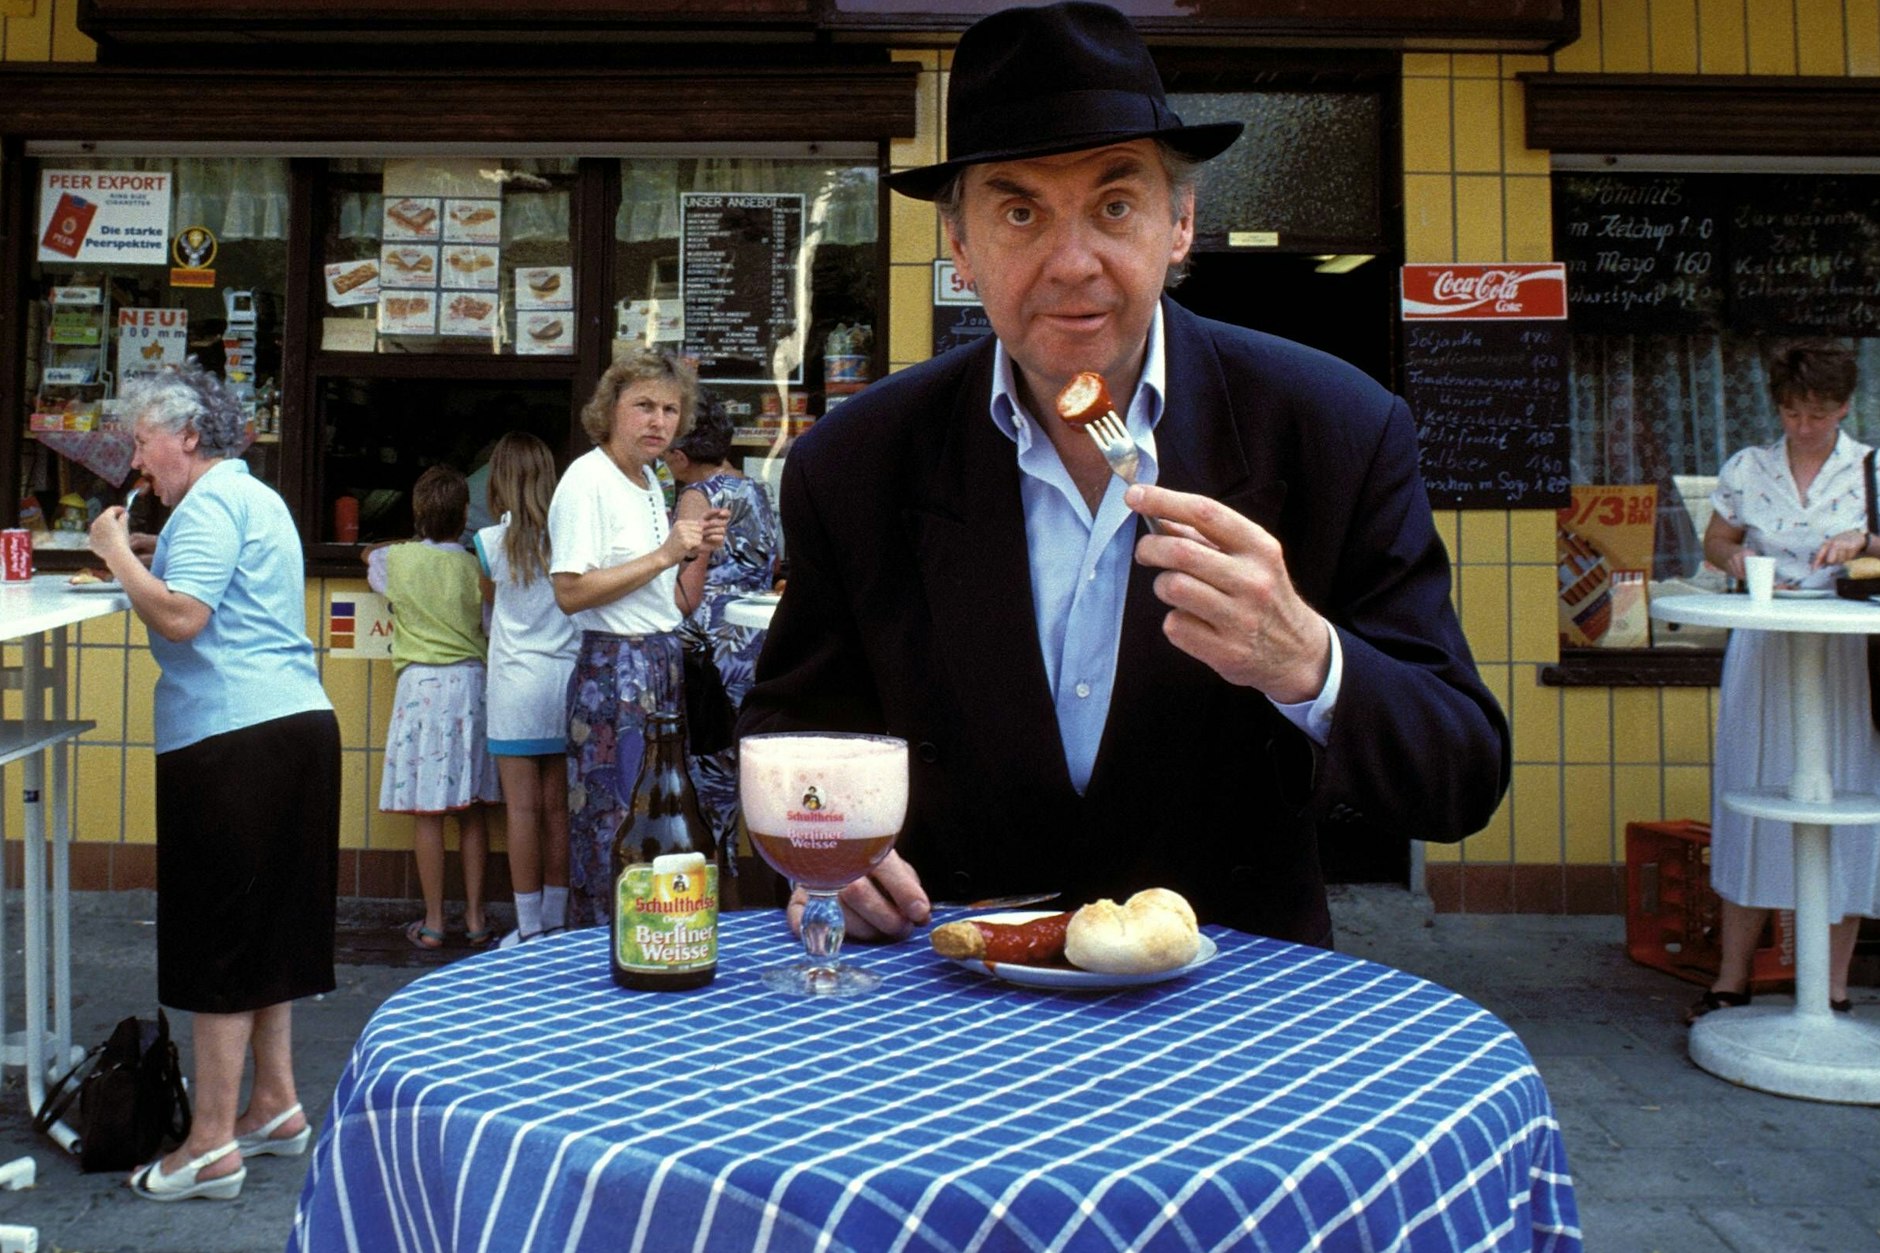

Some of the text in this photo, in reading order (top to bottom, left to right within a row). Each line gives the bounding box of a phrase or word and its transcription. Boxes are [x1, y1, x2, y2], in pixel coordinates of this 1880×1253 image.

[50, 175, 167, 191] PEER EXPORT
[684, 197, 722, 208] UNSER
[101, 226, 163, 236] Die starke
[1596, 213, 1674, 252] Ketchup
[86, 239, 162, 250] Peerspektive
[1596, 250, 1656, 284] Mayo
[1673, 251, 1712, 274] 160
[1433, 270, 1518, 300] Coca-Cola
[1496, 300, 1523, 313] Coke
[787, 811, 845, 822] Schultheiss
[787, 828, 842, 840] Berliner
[790, 838, 838, 849] Weisse
[635, 895, 715, 914] Schultheiss
[635, 923, 714, 945] Berliner
[641, 944, 709, 963] Weisse
